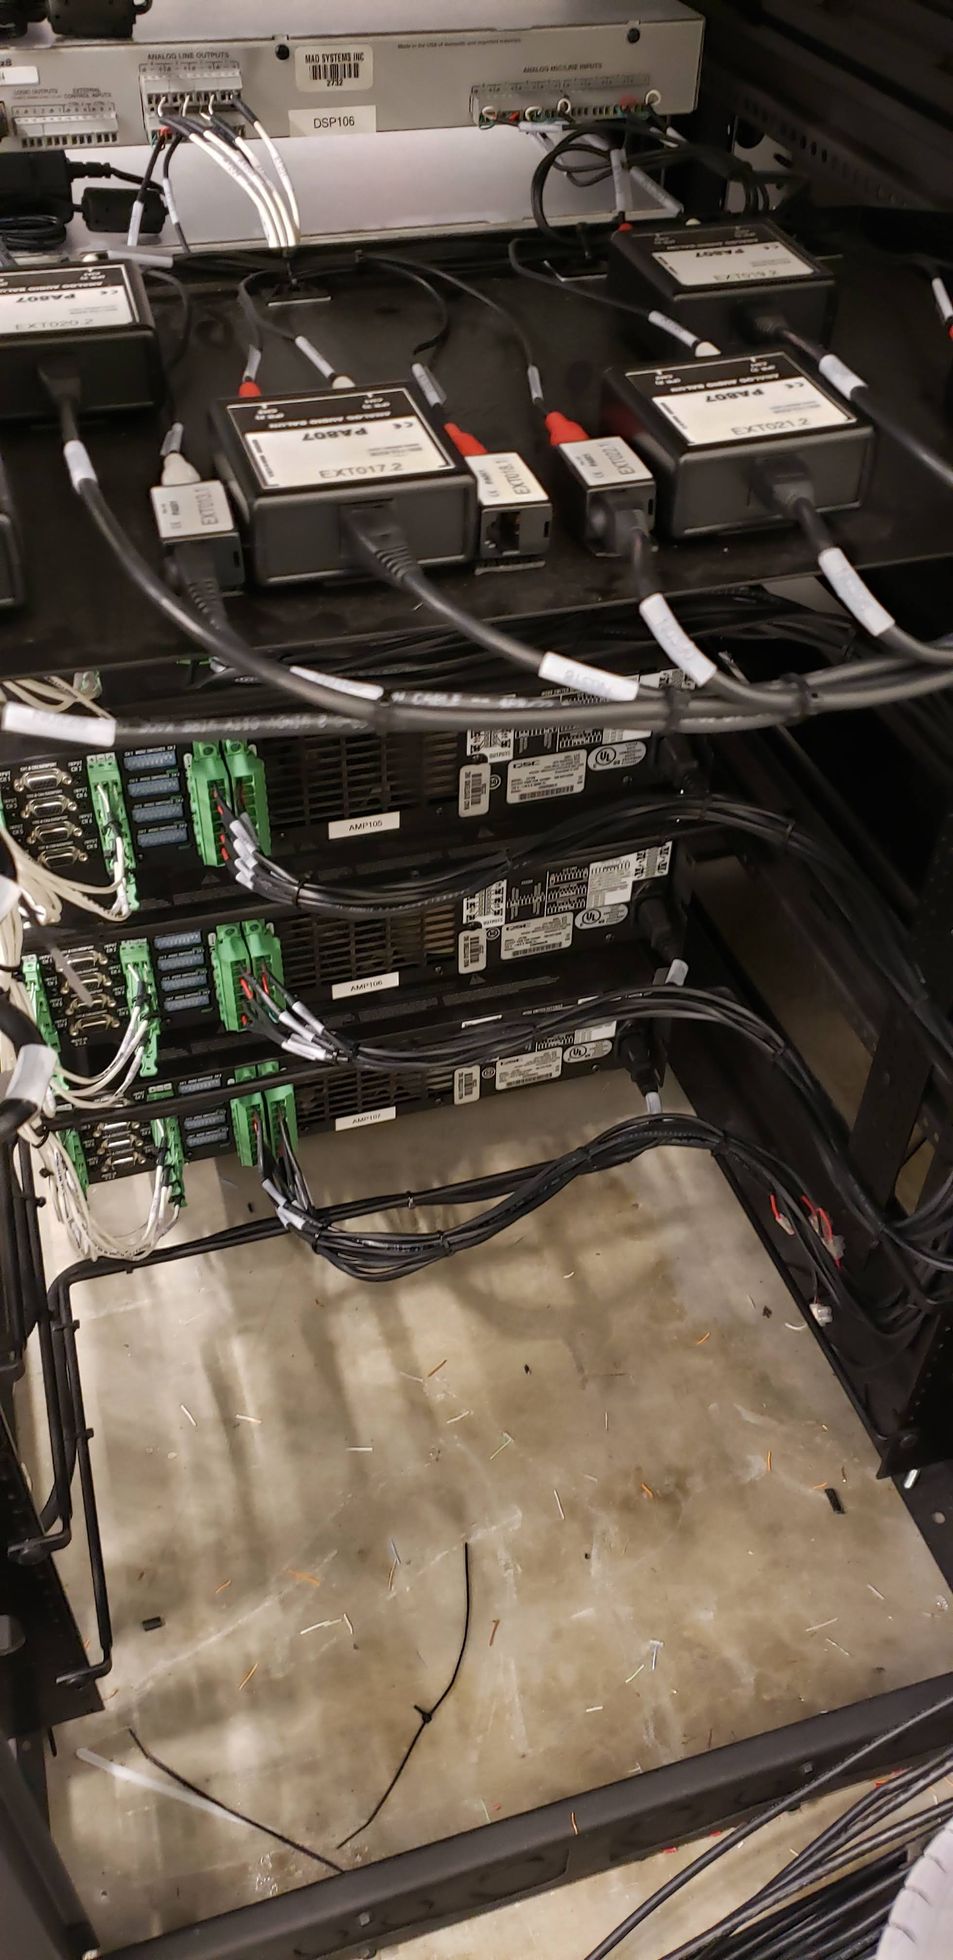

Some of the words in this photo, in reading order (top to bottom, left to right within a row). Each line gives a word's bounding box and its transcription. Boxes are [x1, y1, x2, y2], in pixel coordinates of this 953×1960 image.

[196, 51, 230, 59] OUTPUTS
[304, 54, 320, 64] MAD
[321, 52, 352, 63] SYSTEMS
[353, 51, 364, 62] INC
[522, 64, 549, 73] ANALOG
[312, 115, 356, 129] DSP106
[15, 292, 77, 304] PA807
[704, 387, 766, 404] PA807
[301, 426, 370, 443] PA807
[318, 461, 405, 481] EXT017.2
[600, 751, 611, 762] UL
[348, 820, 383, 832] AMP105
[350, 980, 383, 992] AMP106
